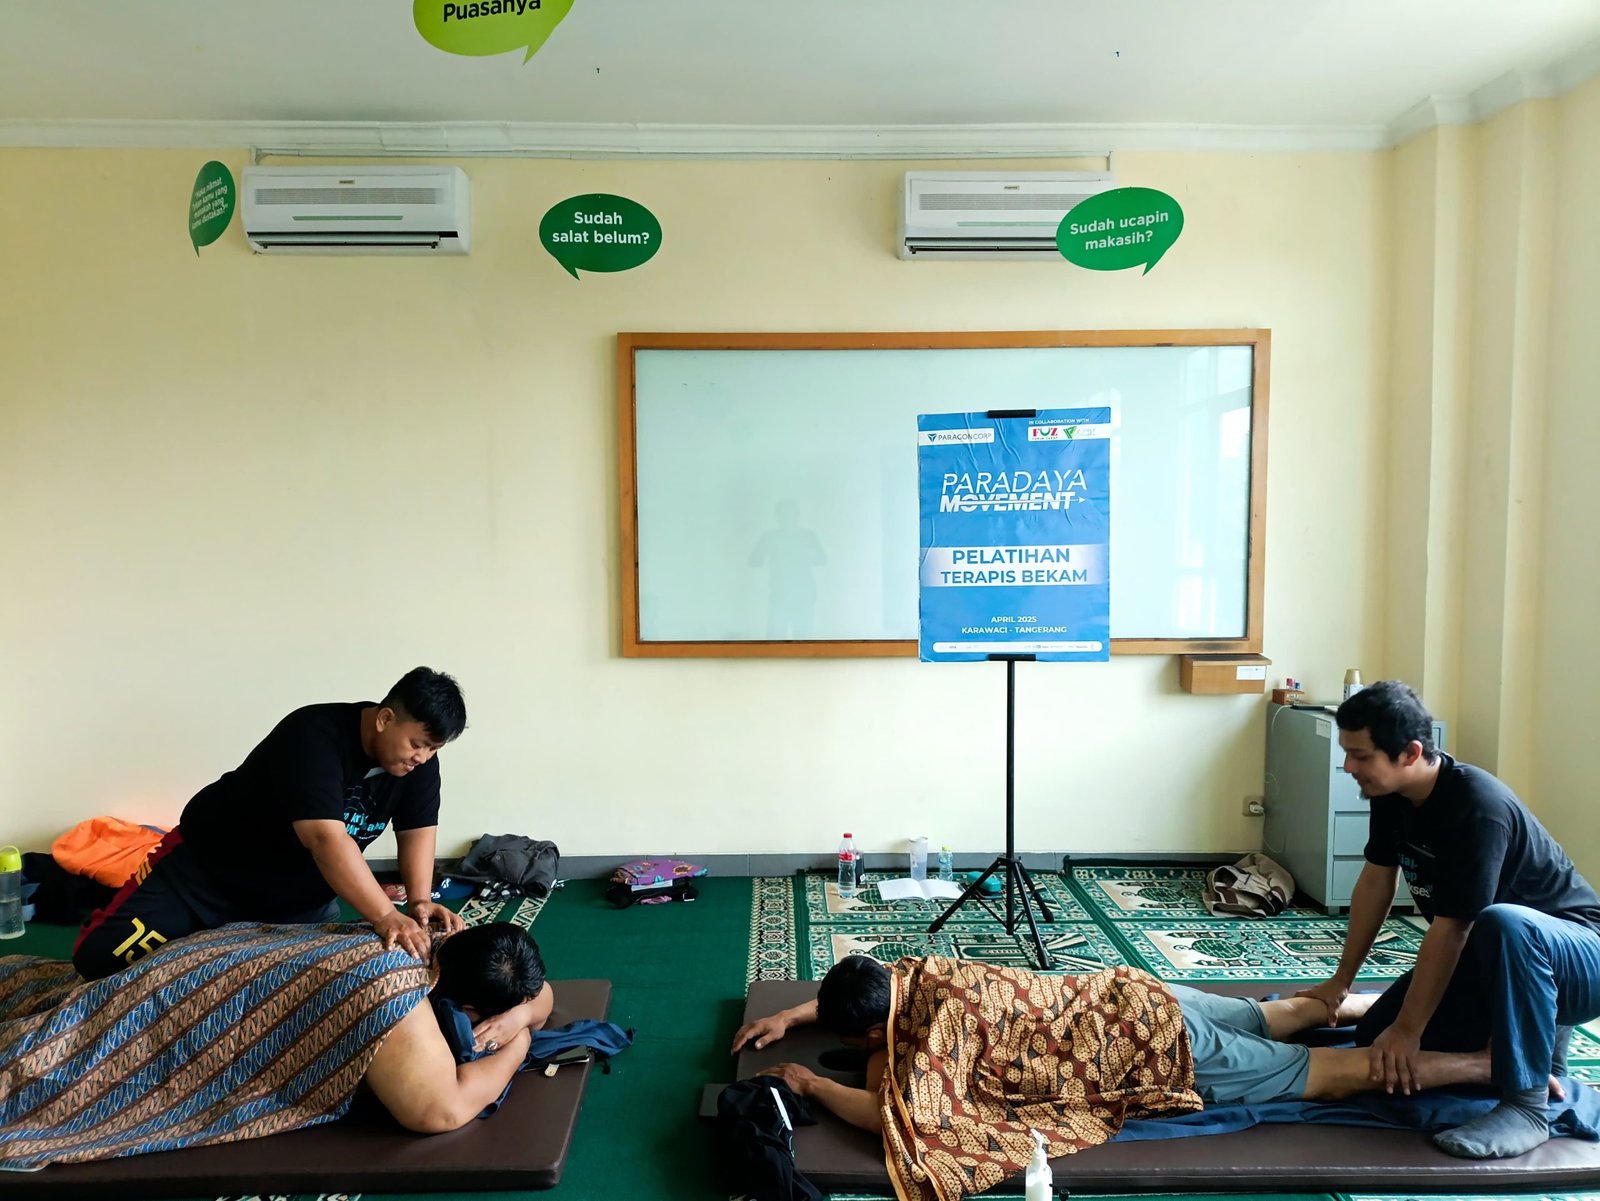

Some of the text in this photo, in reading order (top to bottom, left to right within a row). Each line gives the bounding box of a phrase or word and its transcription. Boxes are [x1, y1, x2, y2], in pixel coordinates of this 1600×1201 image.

[443, 0, 541, 22] Puasanya
[574, 211, 623, 225] Sudah
[1070, 211, 1169, 235] Sudah ucapin
[552, 229, 650, 244] salat belum?
[1085, 230, 1154, 250] makasih?
[942, 469, 1088, 494] PARADAYA
[939, 491, 1076, 513] MOVEMENT
[952, 548, 1070, 565] PELATIHAN
[940, 569, 1088, 584] TERAPIS BEKAM
[961, 626, 1008, 634] KARAWACI
[1014, 626, 1068, 634] TANGERANG
